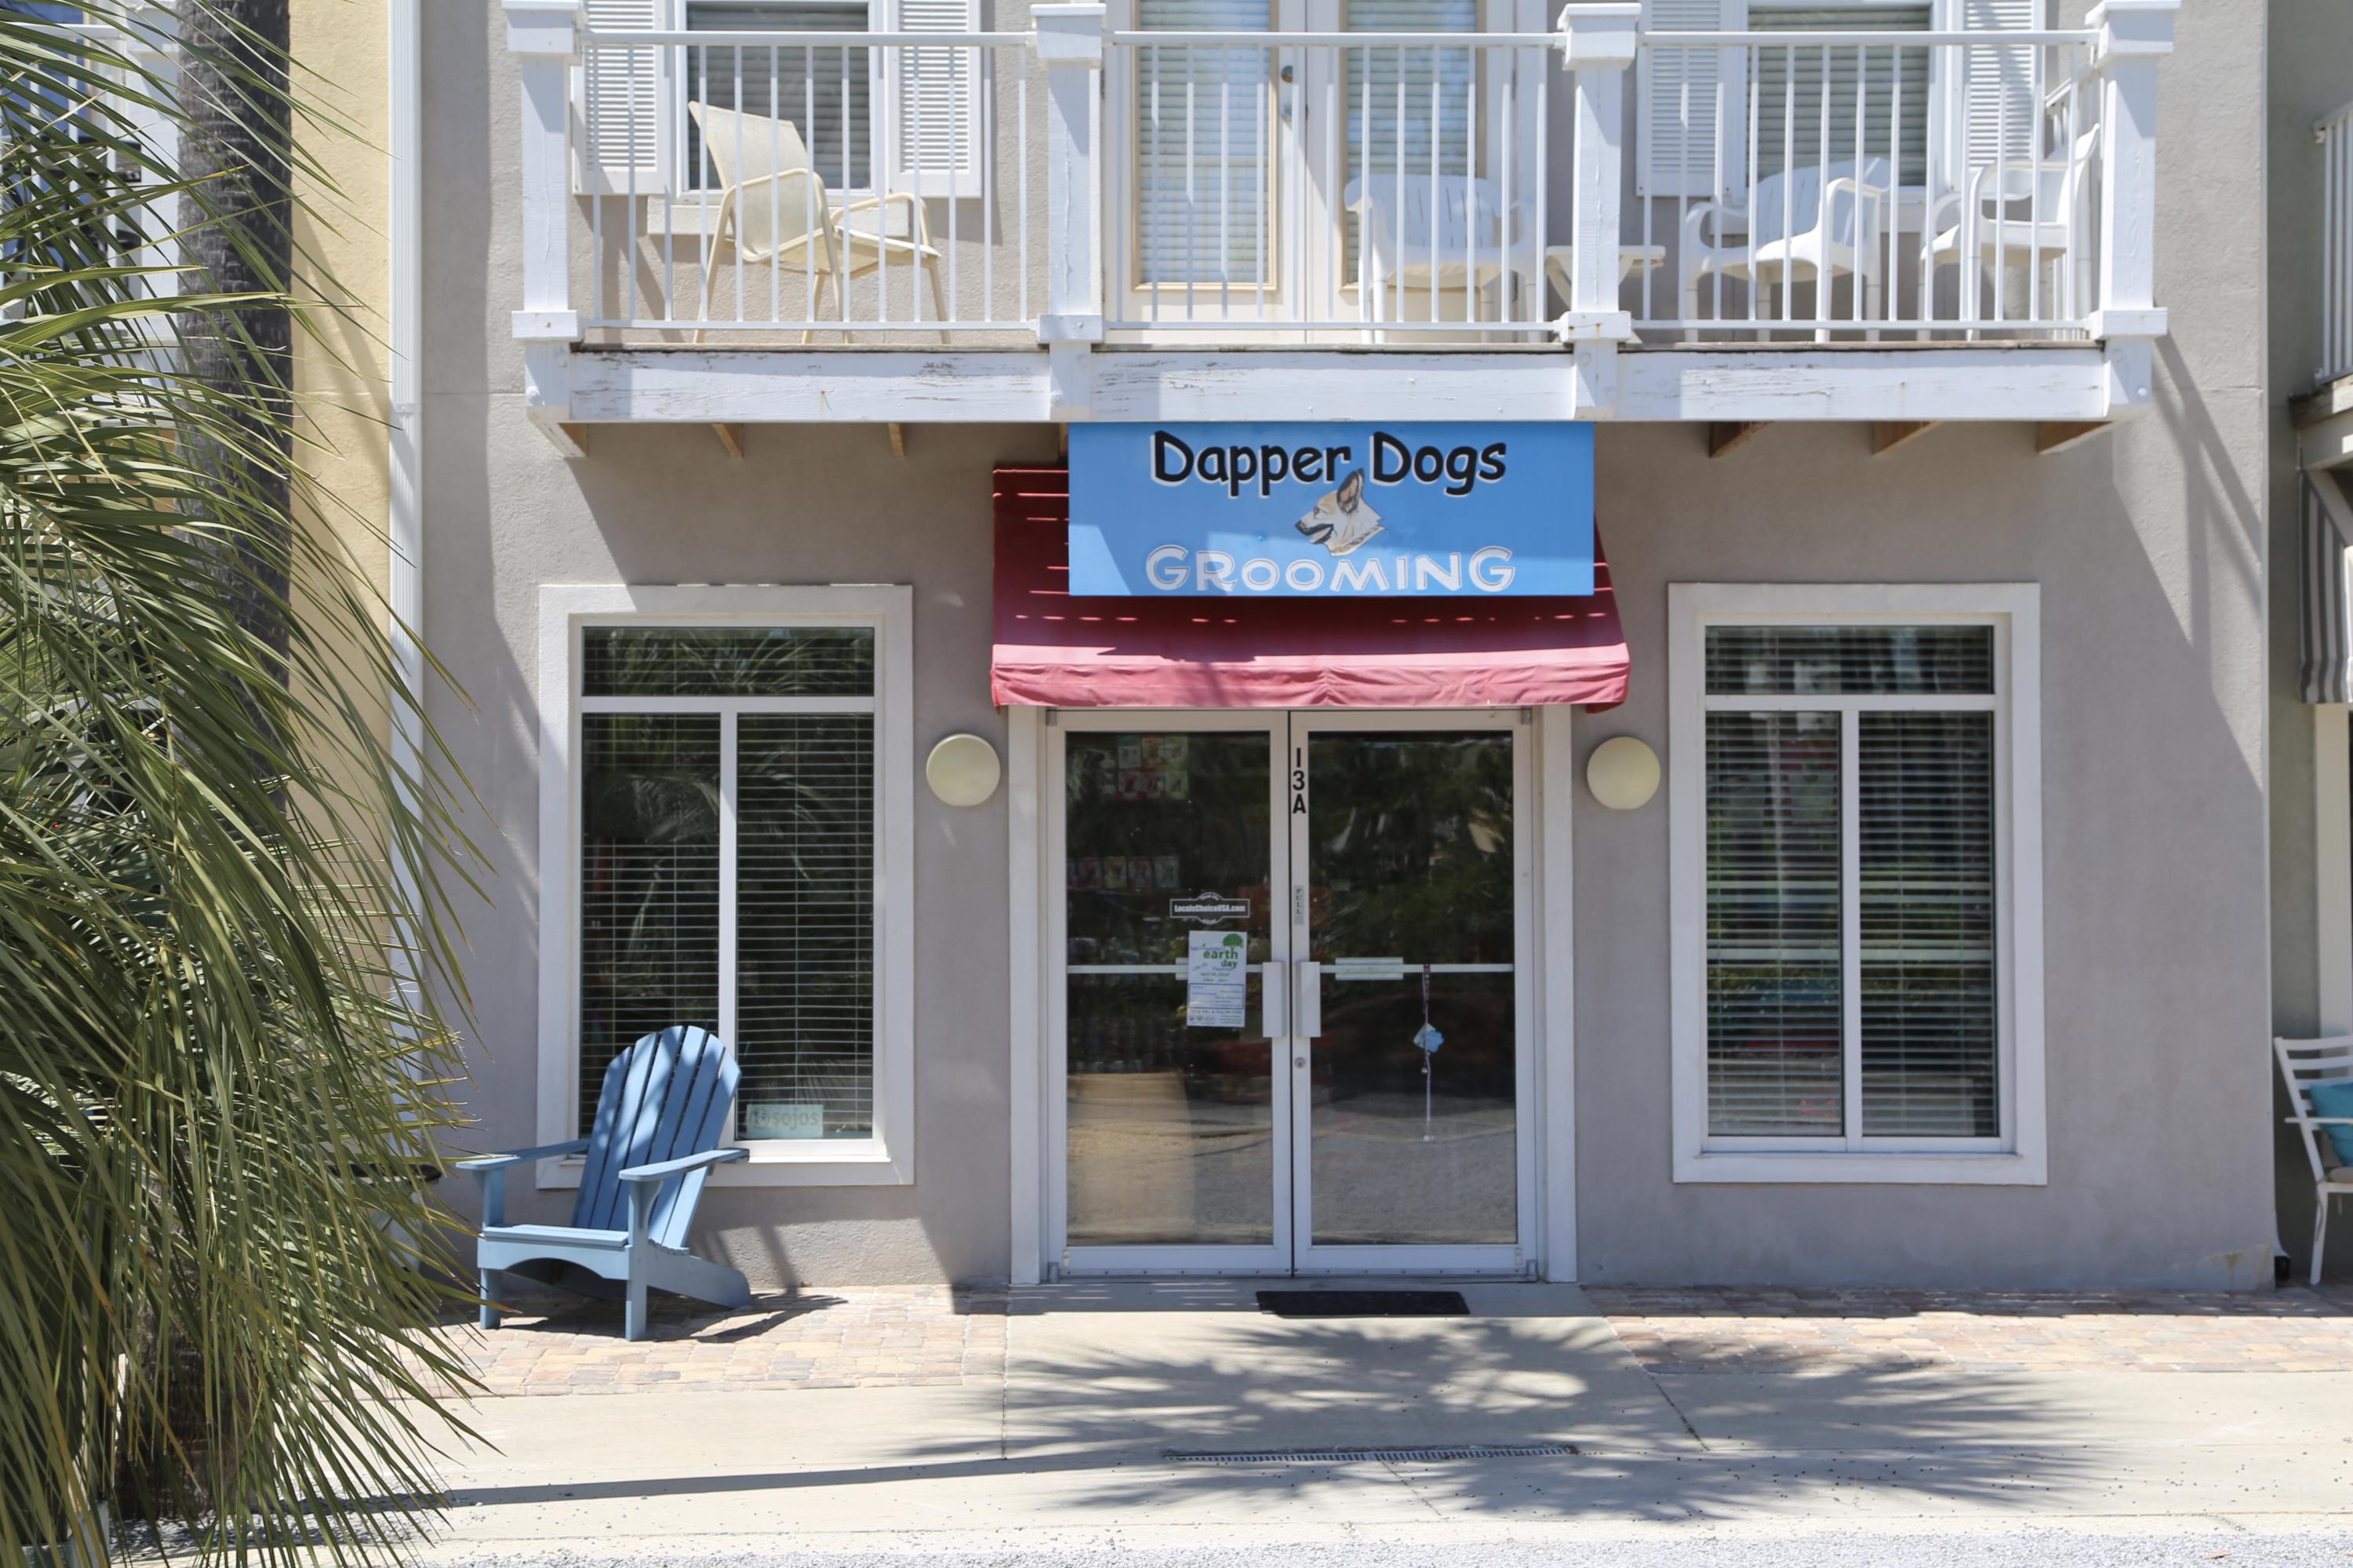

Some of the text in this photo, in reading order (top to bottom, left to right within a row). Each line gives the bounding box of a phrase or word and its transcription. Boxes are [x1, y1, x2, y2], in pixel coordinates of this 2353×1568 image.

[1151, 430, 1507, 498] Dapper Dogs
[1146, 544, 1516, 591] GROOMING
[1293, 748, 1306, 813] 13A
[1203, 948, 1238, 959] earth
[1221, 959, 1238, 970] day
[772, 1108, 818, 1130] sojos
